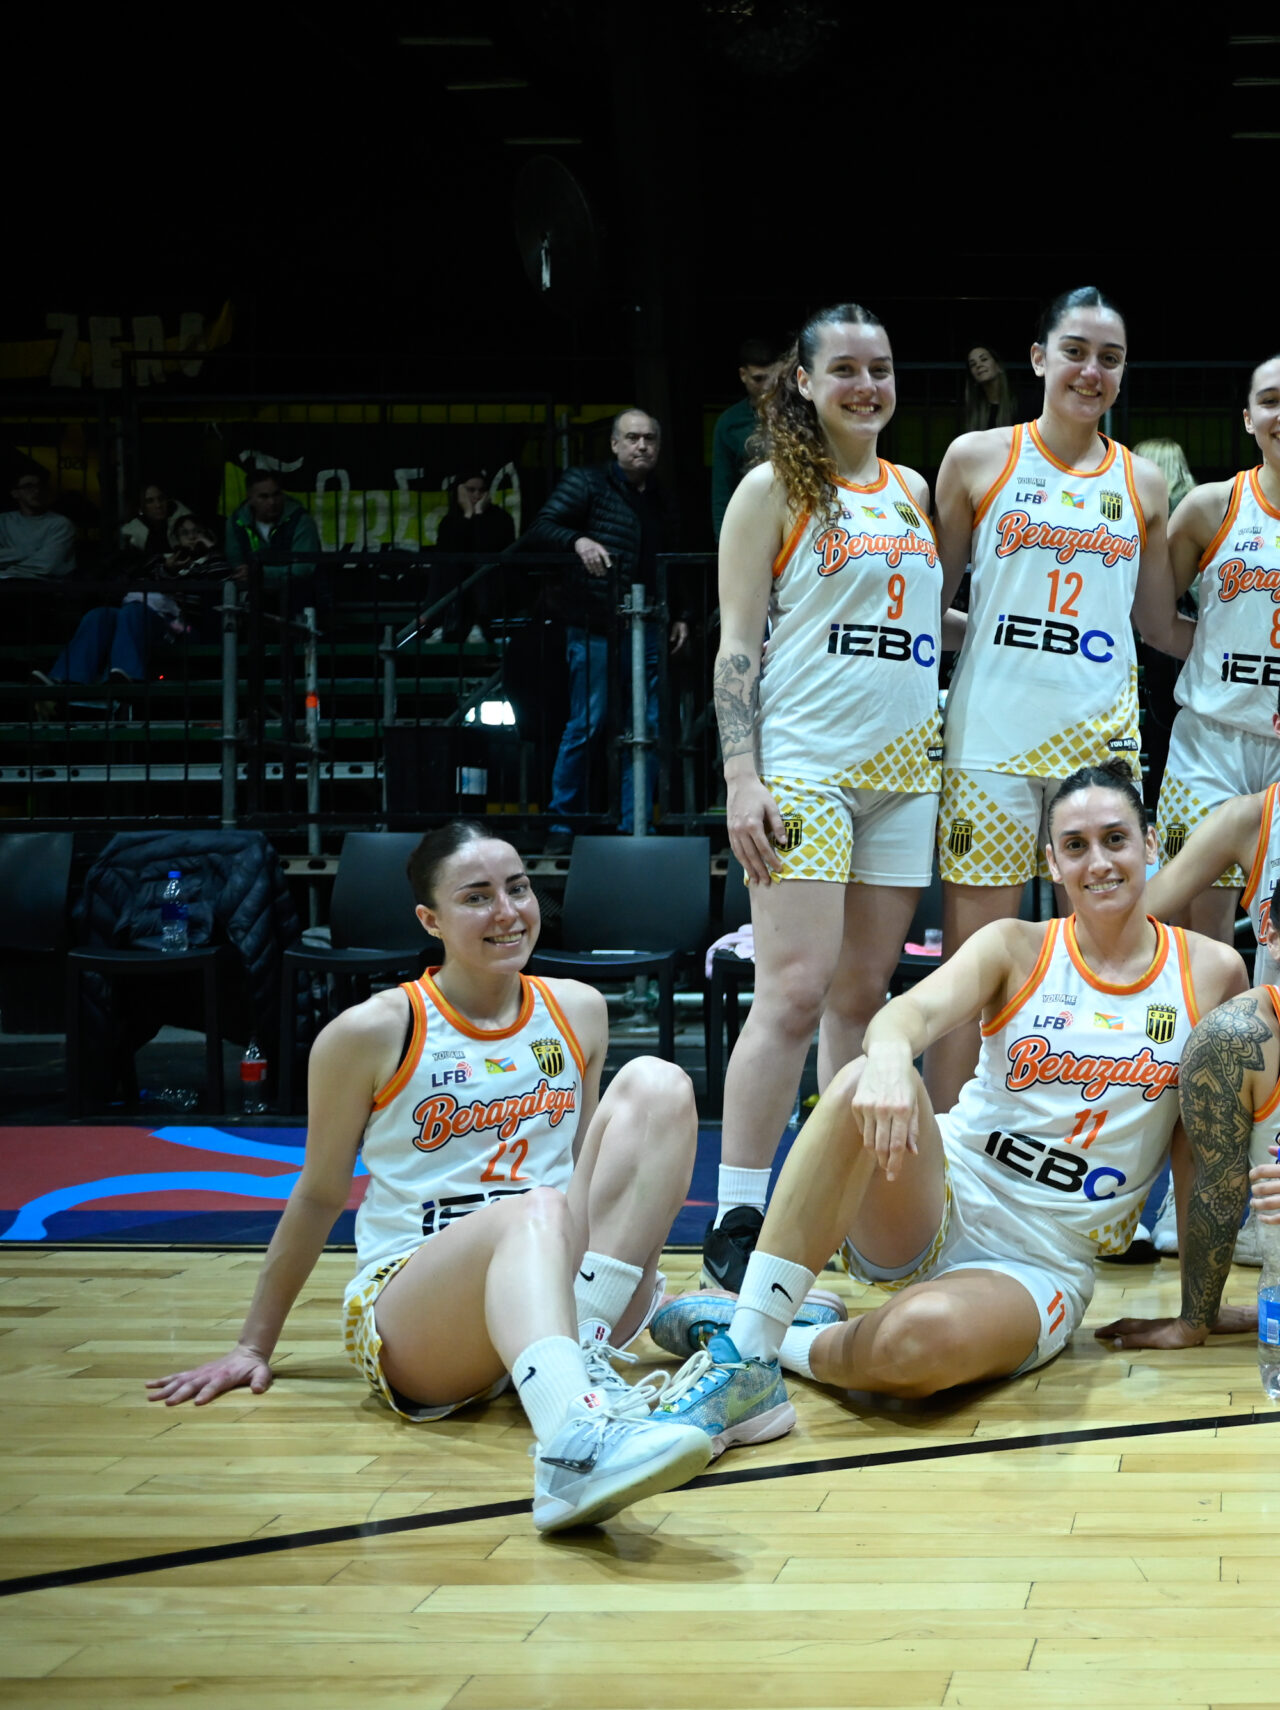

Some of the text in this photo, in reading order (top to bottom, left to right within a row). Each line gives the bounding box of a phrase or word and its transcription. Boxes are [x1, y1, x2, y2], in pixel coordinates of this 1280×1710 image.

[1015, 491, 1042, 504] LFB
[996, 509, 1139, 568] Berazategui
[1234, 541, 1258, 552] LFB
[887, 573, 906, 620] 9
[1047, 569, 1083, 617] 12
[1033, 1014, 1066, 1030] LFB
[432, 1069, 467, 1088] LFB
[1064, 1109, 1109, 1150] 11
[480, 1138, 529, 1183] 22
